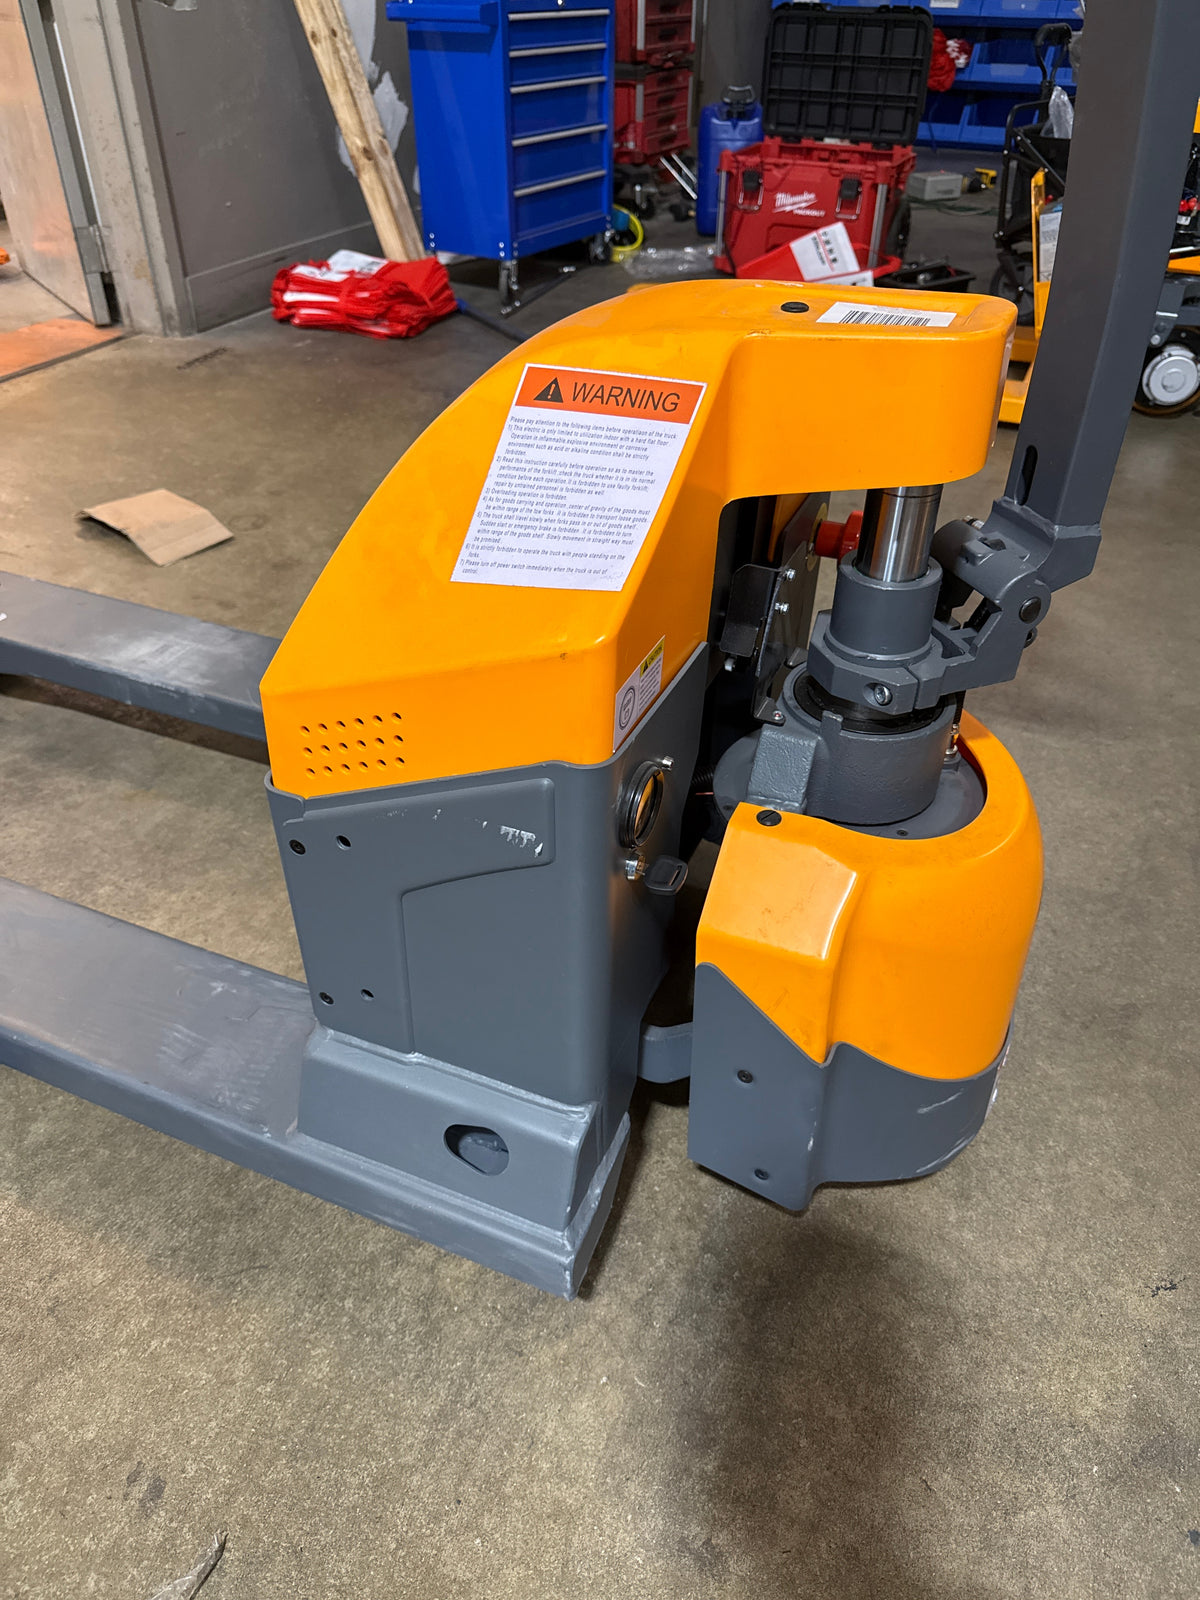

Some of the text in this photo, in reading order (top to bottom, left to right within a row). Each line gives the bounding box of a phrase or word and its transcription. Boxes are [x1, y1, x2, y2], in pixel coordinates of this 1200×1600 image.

[572, 382, 680, 413] WARNING
[570, 422, 591, 430] following
[491, 488, 517, 496] Overloading
